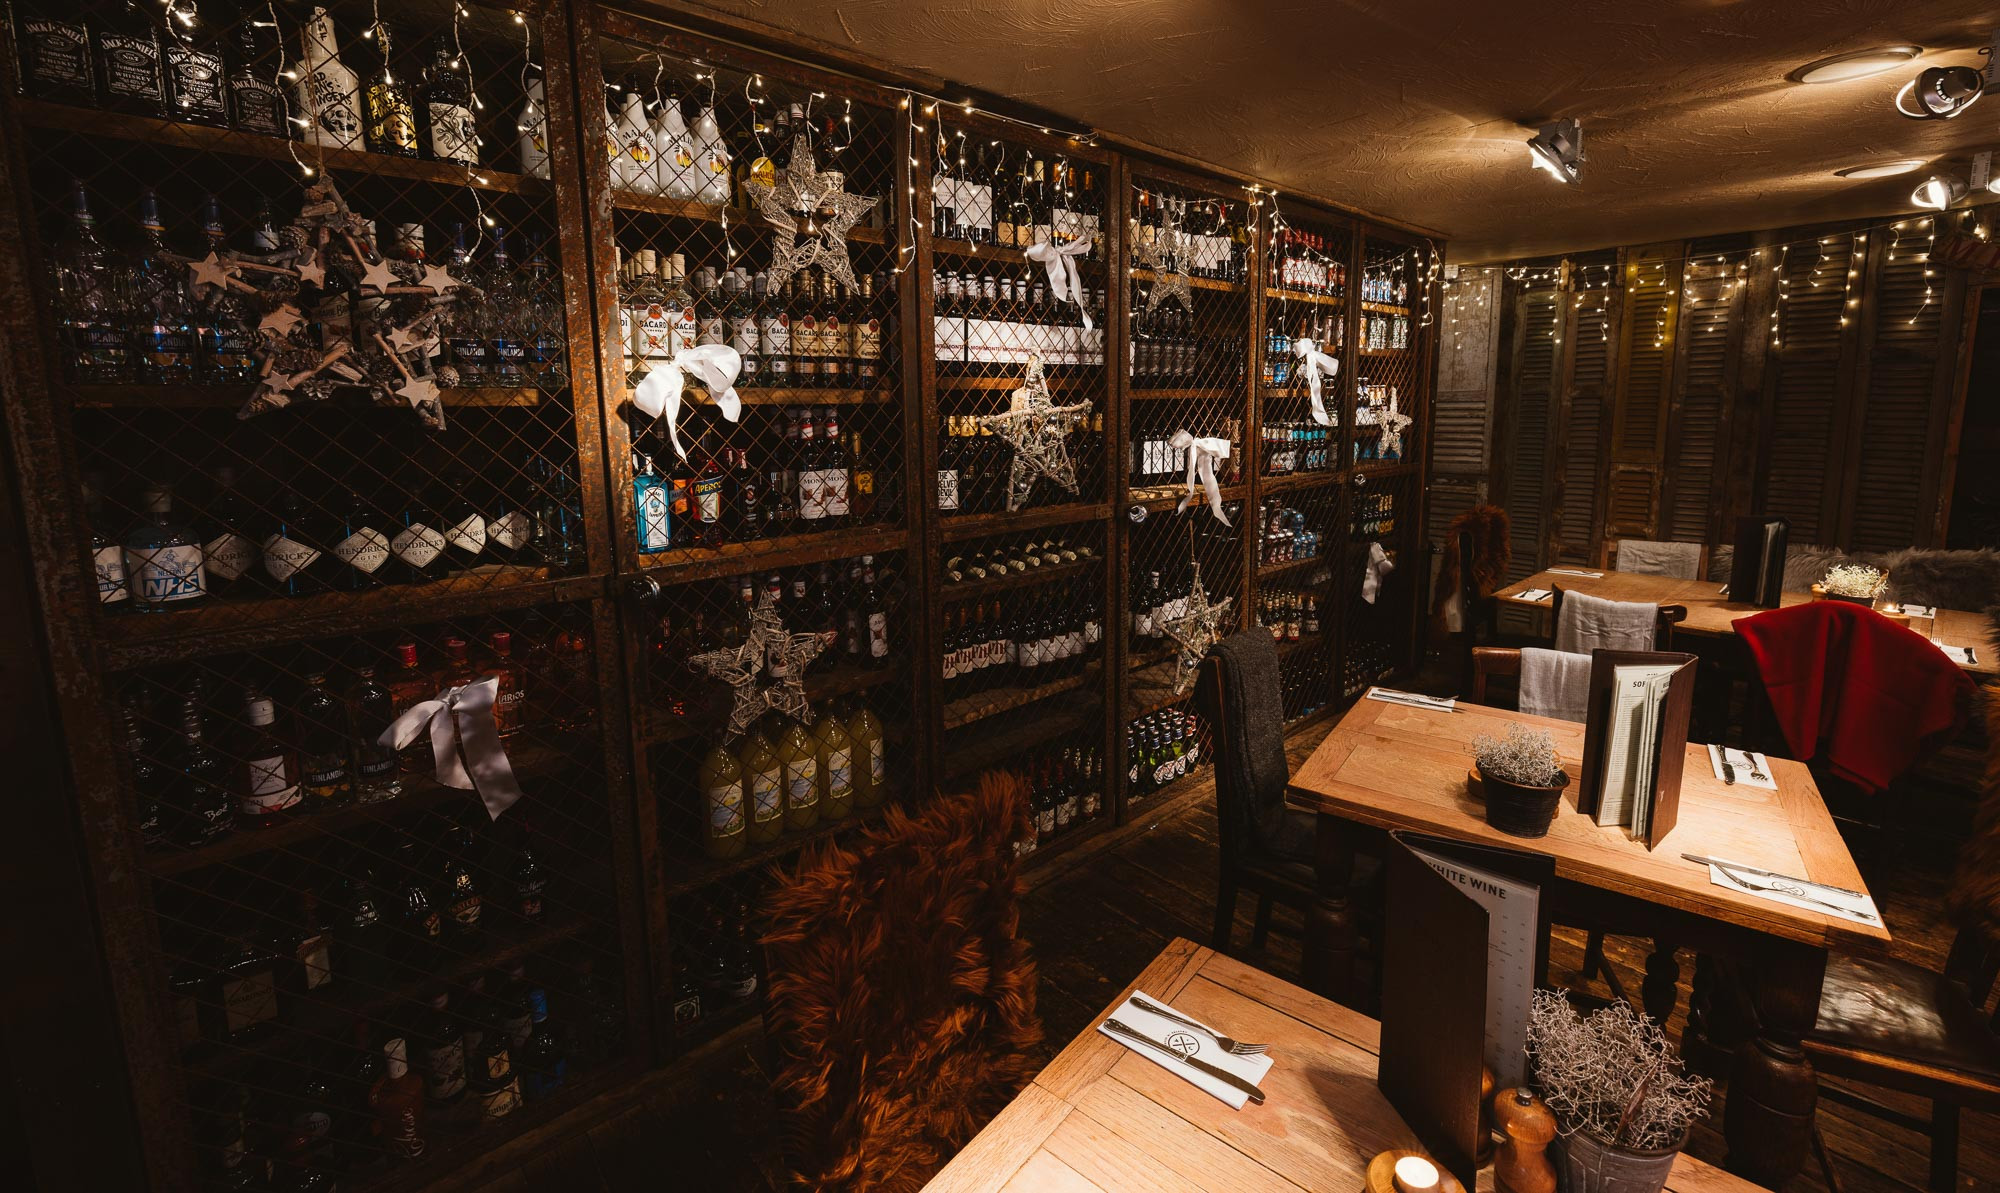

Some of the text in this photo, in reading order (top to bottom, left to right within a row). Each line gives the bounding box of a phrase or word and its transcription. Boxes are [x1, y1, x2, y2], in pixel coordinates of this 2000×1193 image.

[24, 22, 47, 34] JACK
[100, 38, 123, 50] JACK
[167, 53, 187, 65] JACK
[187, 53, 222, 74] DANIEL'S
[231, 79, 251, 92] JACK
[251, 77, 279, 98] DANIEL'S
[314, 92, 353, 107] INGERS
[640, 320, 667, 329] BACARD
[674, 322, 695, 331] BACAR
[457, 346, 486, 357] FINLANDIA
[144, 575, 200, 598] NHS
[1632, 680, 1646, 688] SOF
[362, 759, 394, 774] FINLANDIA
[311, 768, 345, 783] FINLANDIA
[1429, 862, 1506, 900] HITE WINE
